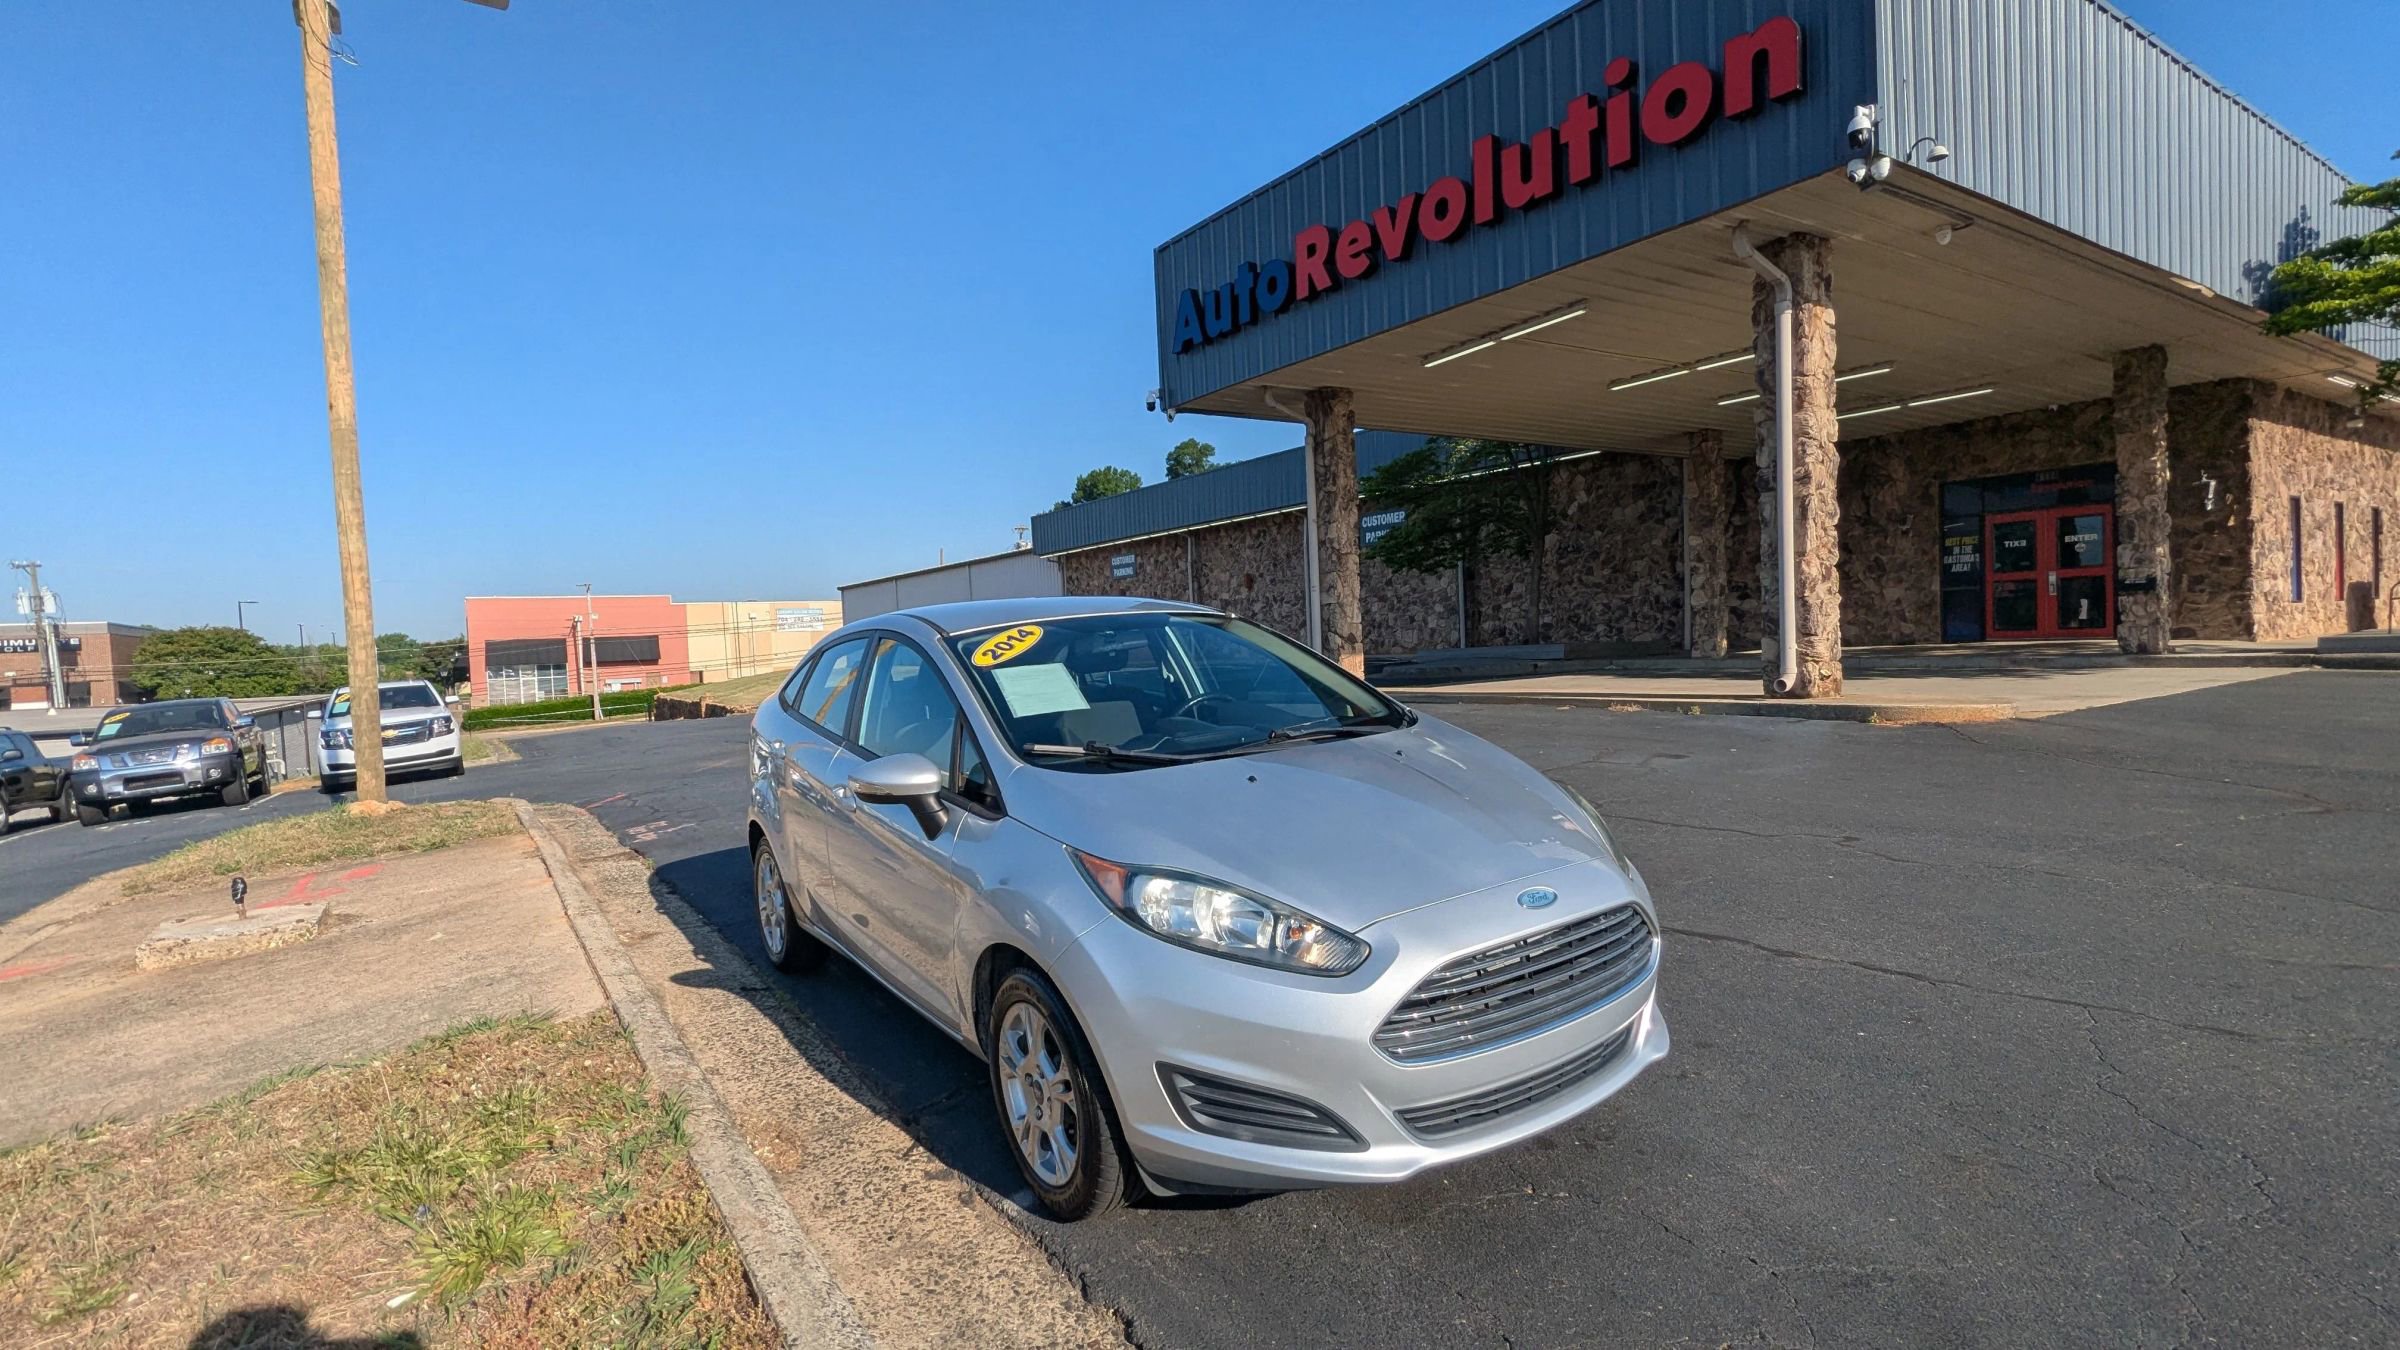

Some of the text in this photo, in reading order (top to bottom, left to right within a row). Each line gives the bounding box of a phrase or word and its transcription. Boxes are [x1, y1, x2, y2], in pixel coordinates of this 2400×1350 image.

[1173, 16, 1803, 354] AutoRevolution
[1361, 511, 1406, 528] CUSTOMER
[2064, 533, 2098, 543] ENTER
[1111, 554, 1135, 566] CUSTOMER
[1113, 566, 1134, 577] PARKING
[981, 625, 1036, 662] 2014
[1527, 891, 1549, 904] Ford
